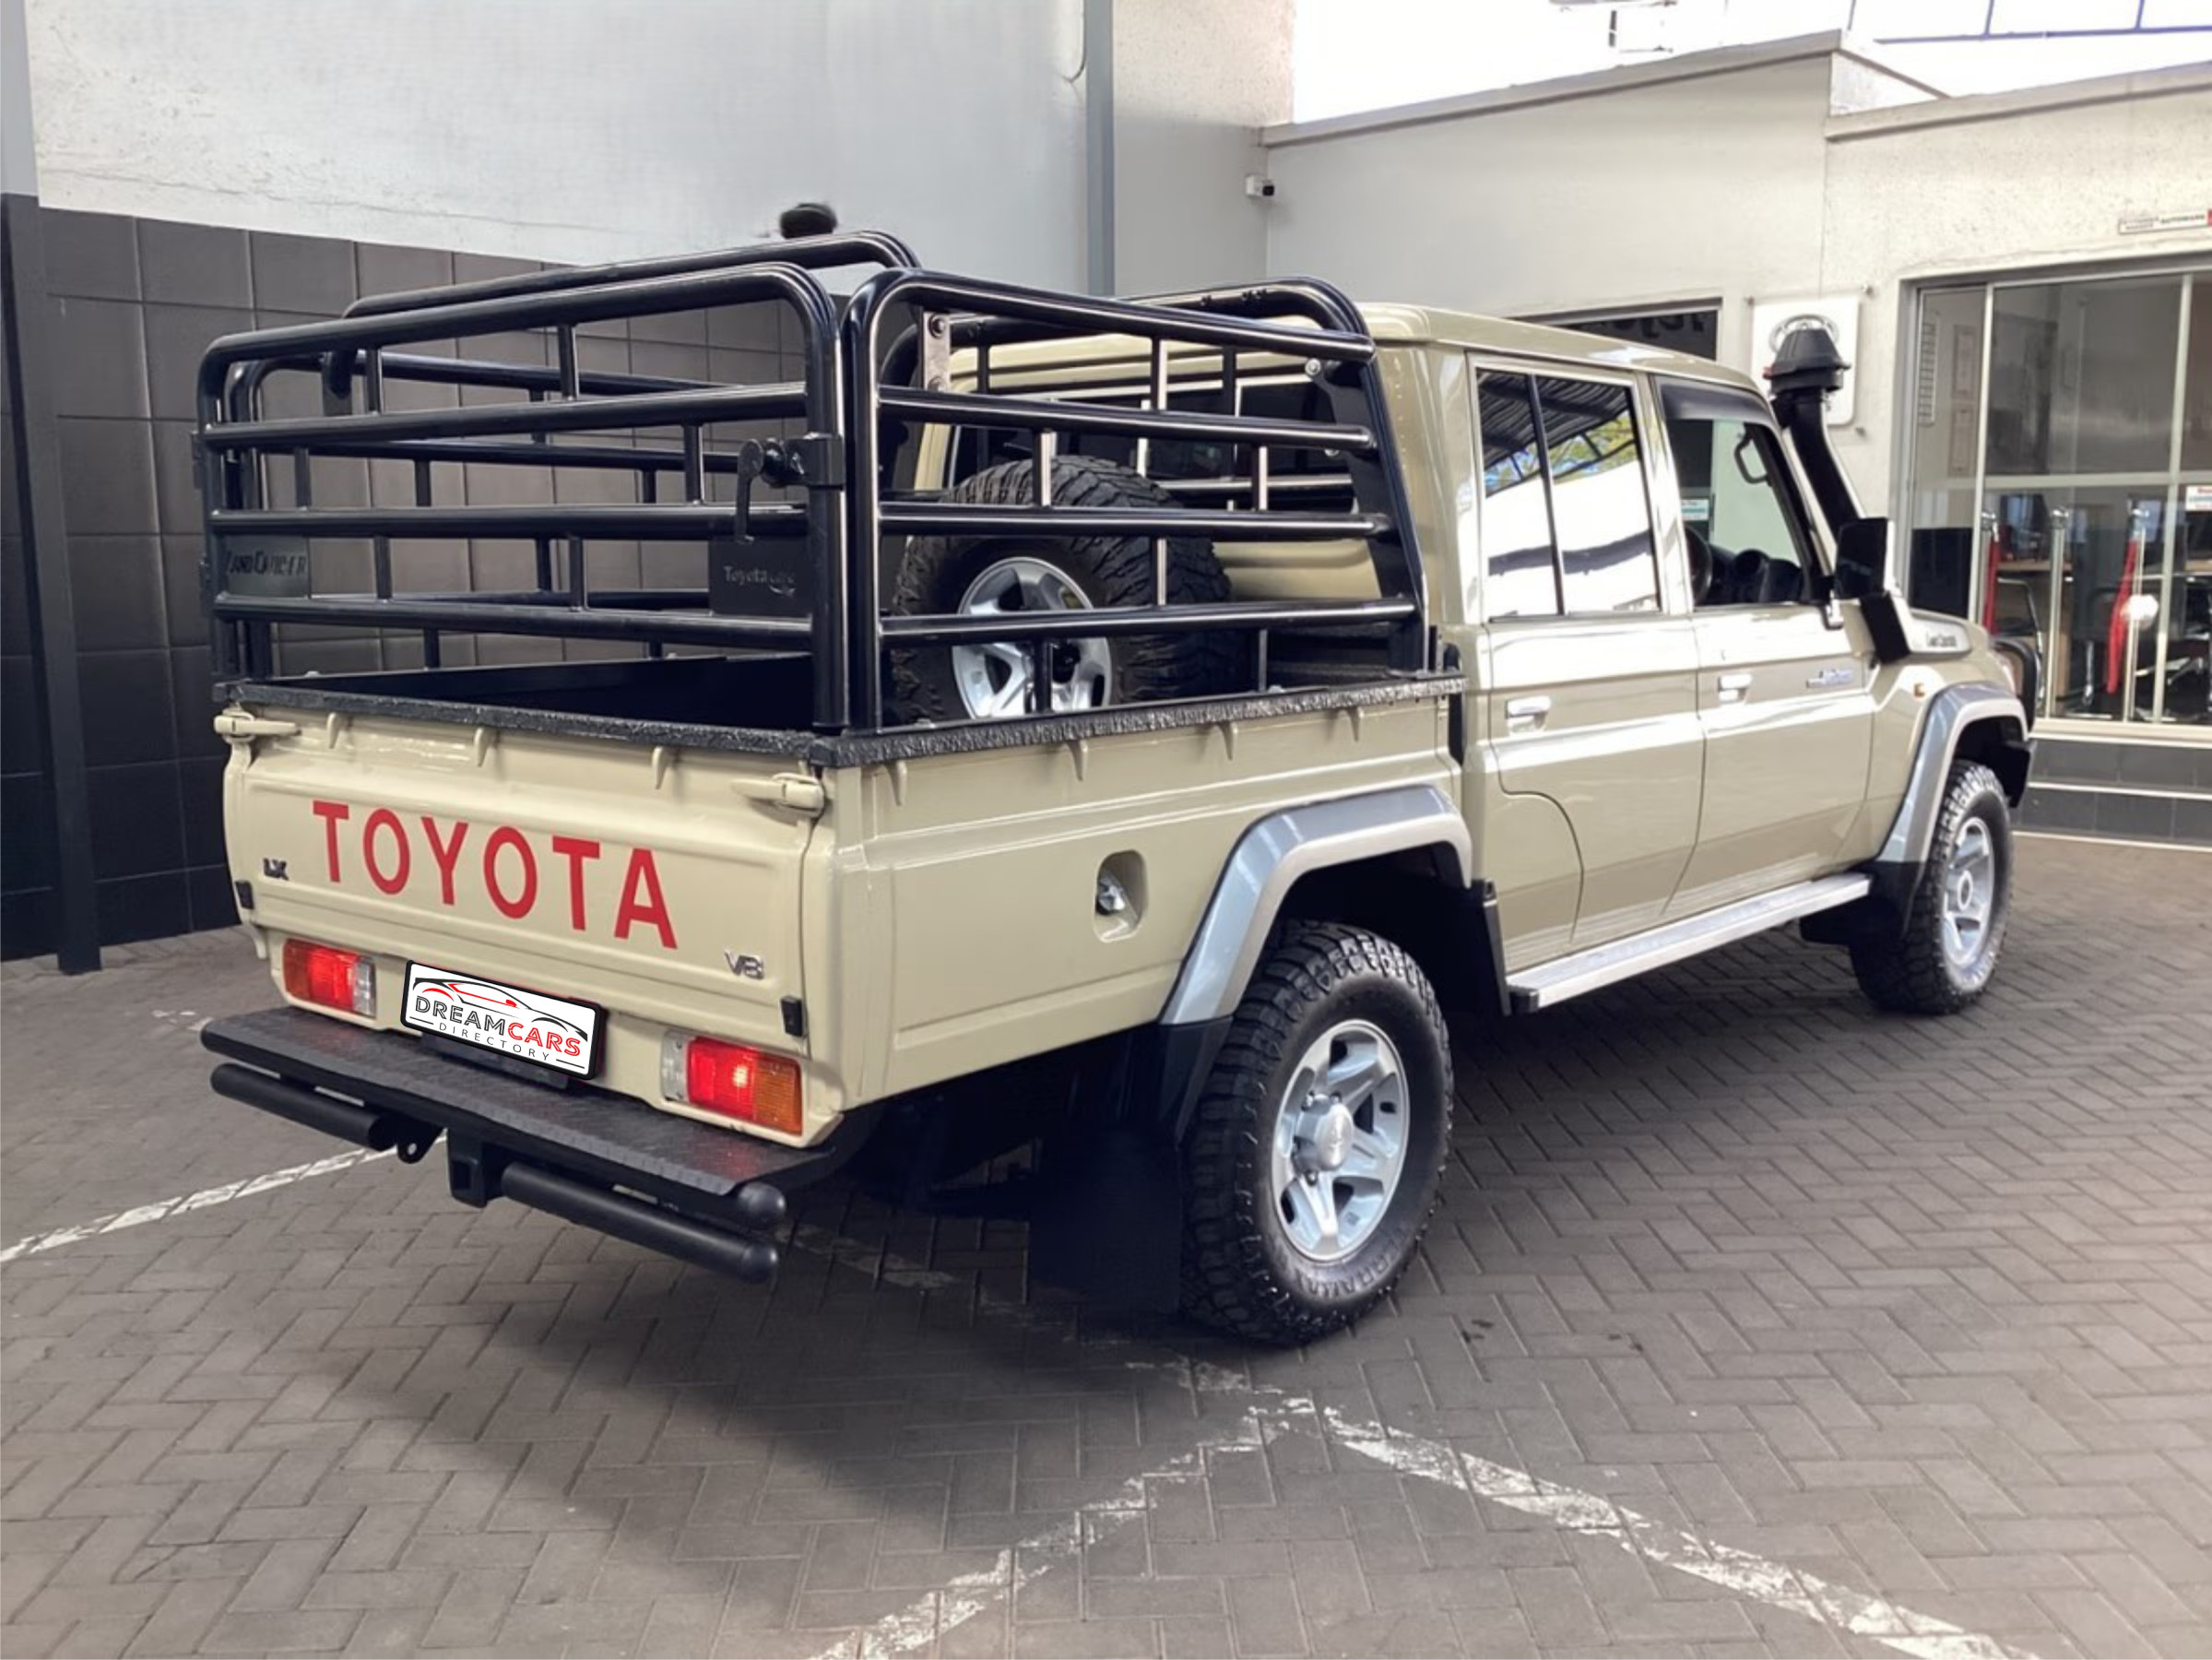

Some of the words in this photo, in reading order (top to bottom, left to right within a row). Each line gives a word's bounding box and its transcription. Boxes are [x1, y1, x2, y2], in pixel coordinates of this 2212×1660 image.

[263, 858, 290, 881] LX
[313, 800, 678, 950] TOYOTA
[724, 950, 764, 980] V8
